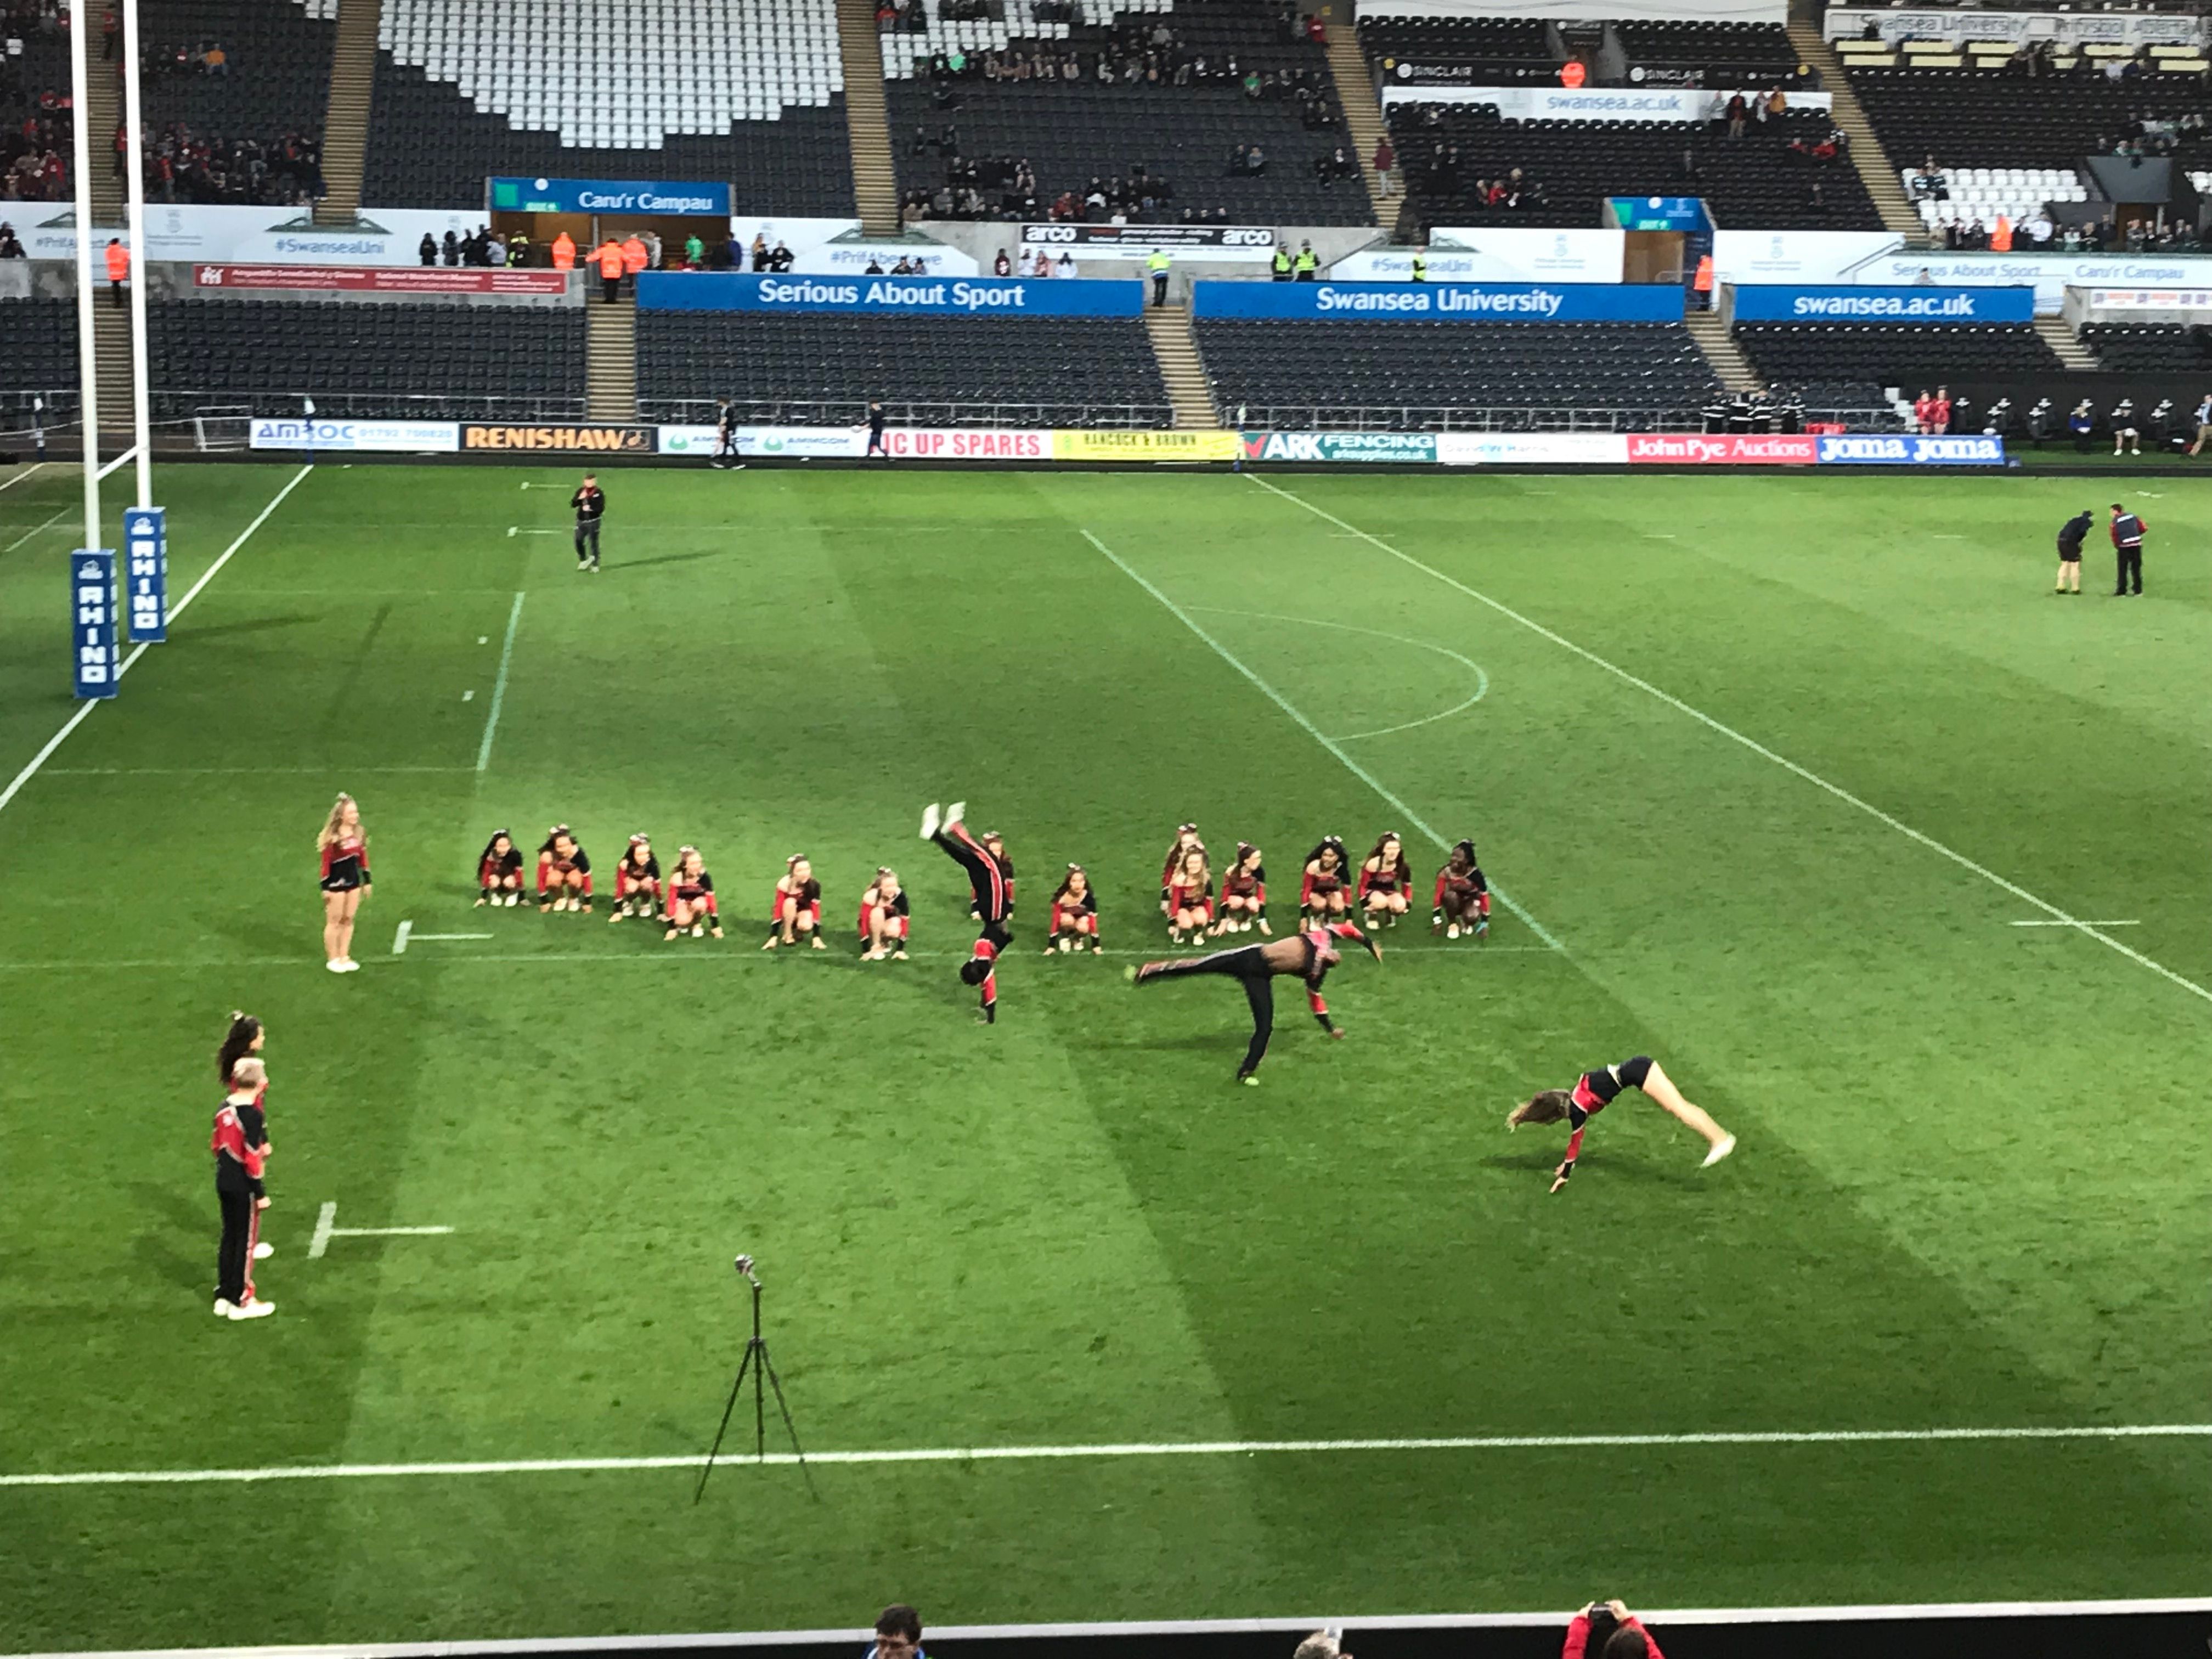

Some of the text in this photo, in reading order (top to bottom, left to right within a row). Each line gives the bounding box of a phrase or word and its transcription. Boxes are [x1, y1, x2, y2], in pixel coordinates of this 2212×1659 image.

[1860, 14, 1936, 31] Sansea
[1547, 95, 1683, 111] swansea.ac.uk
[637, 193, 713, 213] Campau
[1026, 227, 1077, 242] arco
[1222, 229, 1272, 245] arco
[276, 239, 385, 255] #SwanseaUni
[1372, 258, 1473, 272] #SwaeaUni
[1892, 263, 2041, 279] Serius About Sport
[758, 279, 1025, 311] Serious About Sport
[1317, 287, 1564, 317] Swansea University
[1793, 294, 1975, 316] swansea.ac.uk
[466, 426, 626, 450] RENISHAW
[871, 432, 1041, 455] IC UP SPARES
[1264, 433, 1325, 460] ARK
[1324, 435, 1435, 449] FENCING
[1633, 439, 1812, 461] John Pye Auctions
[131, 540, 159, 629] RHINO
[78, 585, 107, 684] RHINO
